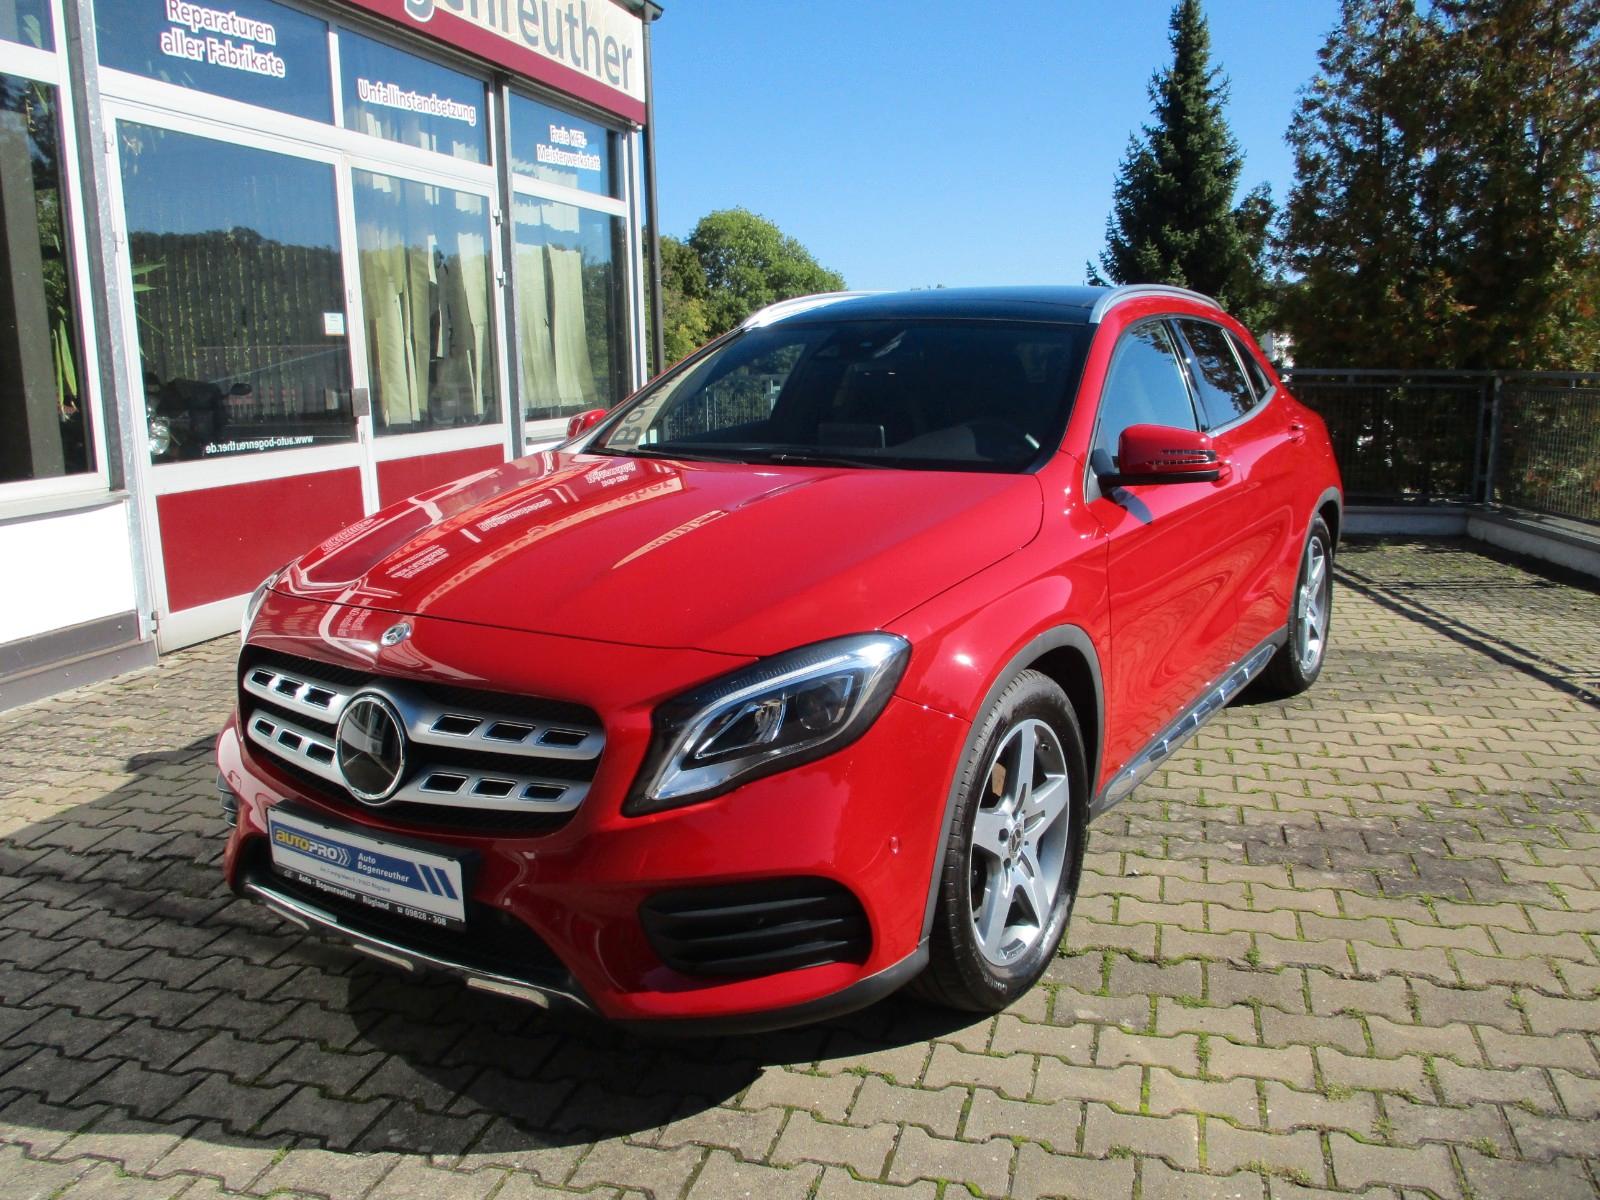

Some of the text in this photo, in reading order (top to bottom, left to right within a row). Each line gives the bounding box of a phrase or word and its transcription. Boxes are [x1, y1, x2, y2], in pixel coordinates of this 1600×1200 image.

[165, 0, 277, 46] Reparaturen
[161, 27, 286, 78] aller Fabrikate
[358, 78, 477, 127] Unfallinstandsetzung
[536, 143, 602, 172] Meisterwerkstatt
[357, 862, 410, 883] Bogenreuther
[358, 852, 377, 866] Auto
